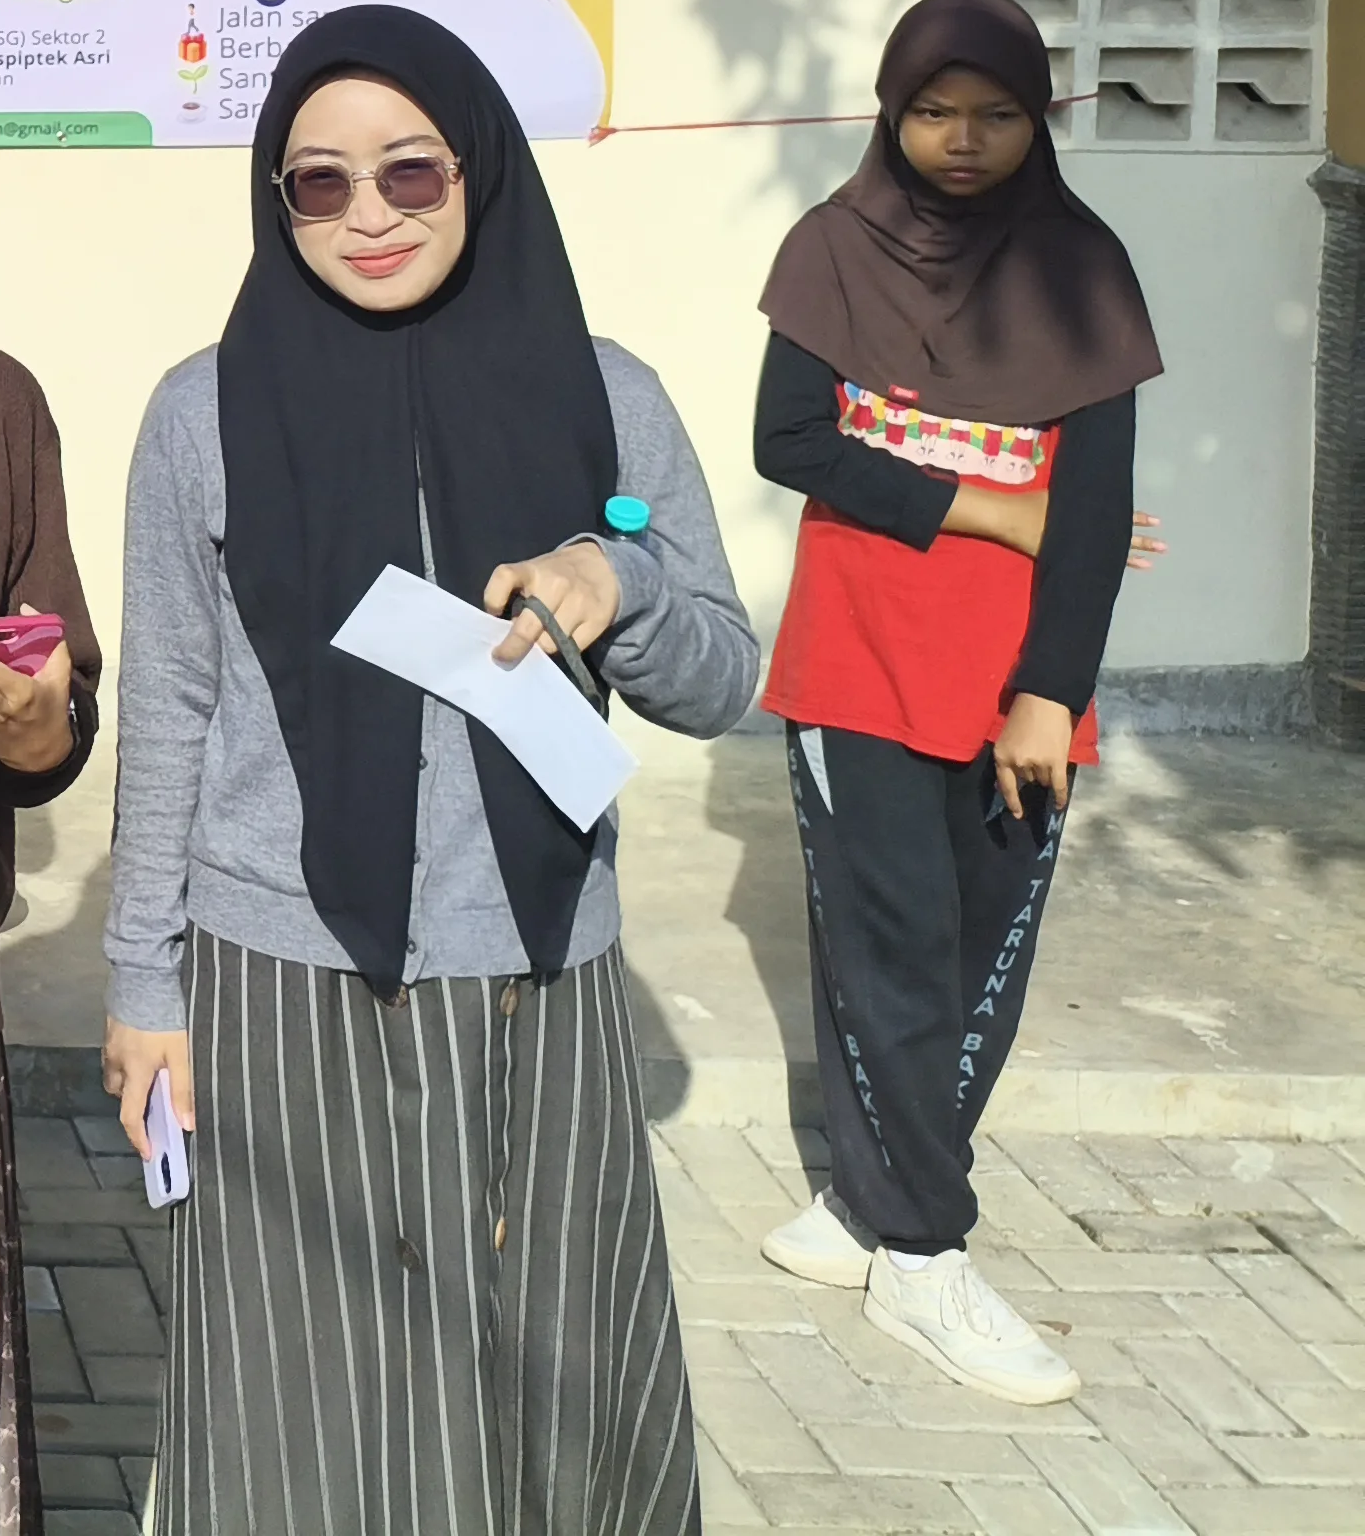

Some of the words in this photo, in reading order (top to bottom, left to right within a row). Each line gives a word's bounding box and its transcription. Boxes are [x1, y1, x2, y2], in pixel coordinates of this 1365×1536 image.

[217, 7, 282, 33] Jalan
[31, 29, 88, 46] Sektor
[95, 29, 106, 45] 2
[73, 49, 111, 65] Asri
[1036, 812, 1063, 861] MA
[973, 879, 1044, 1016] TARUNA
